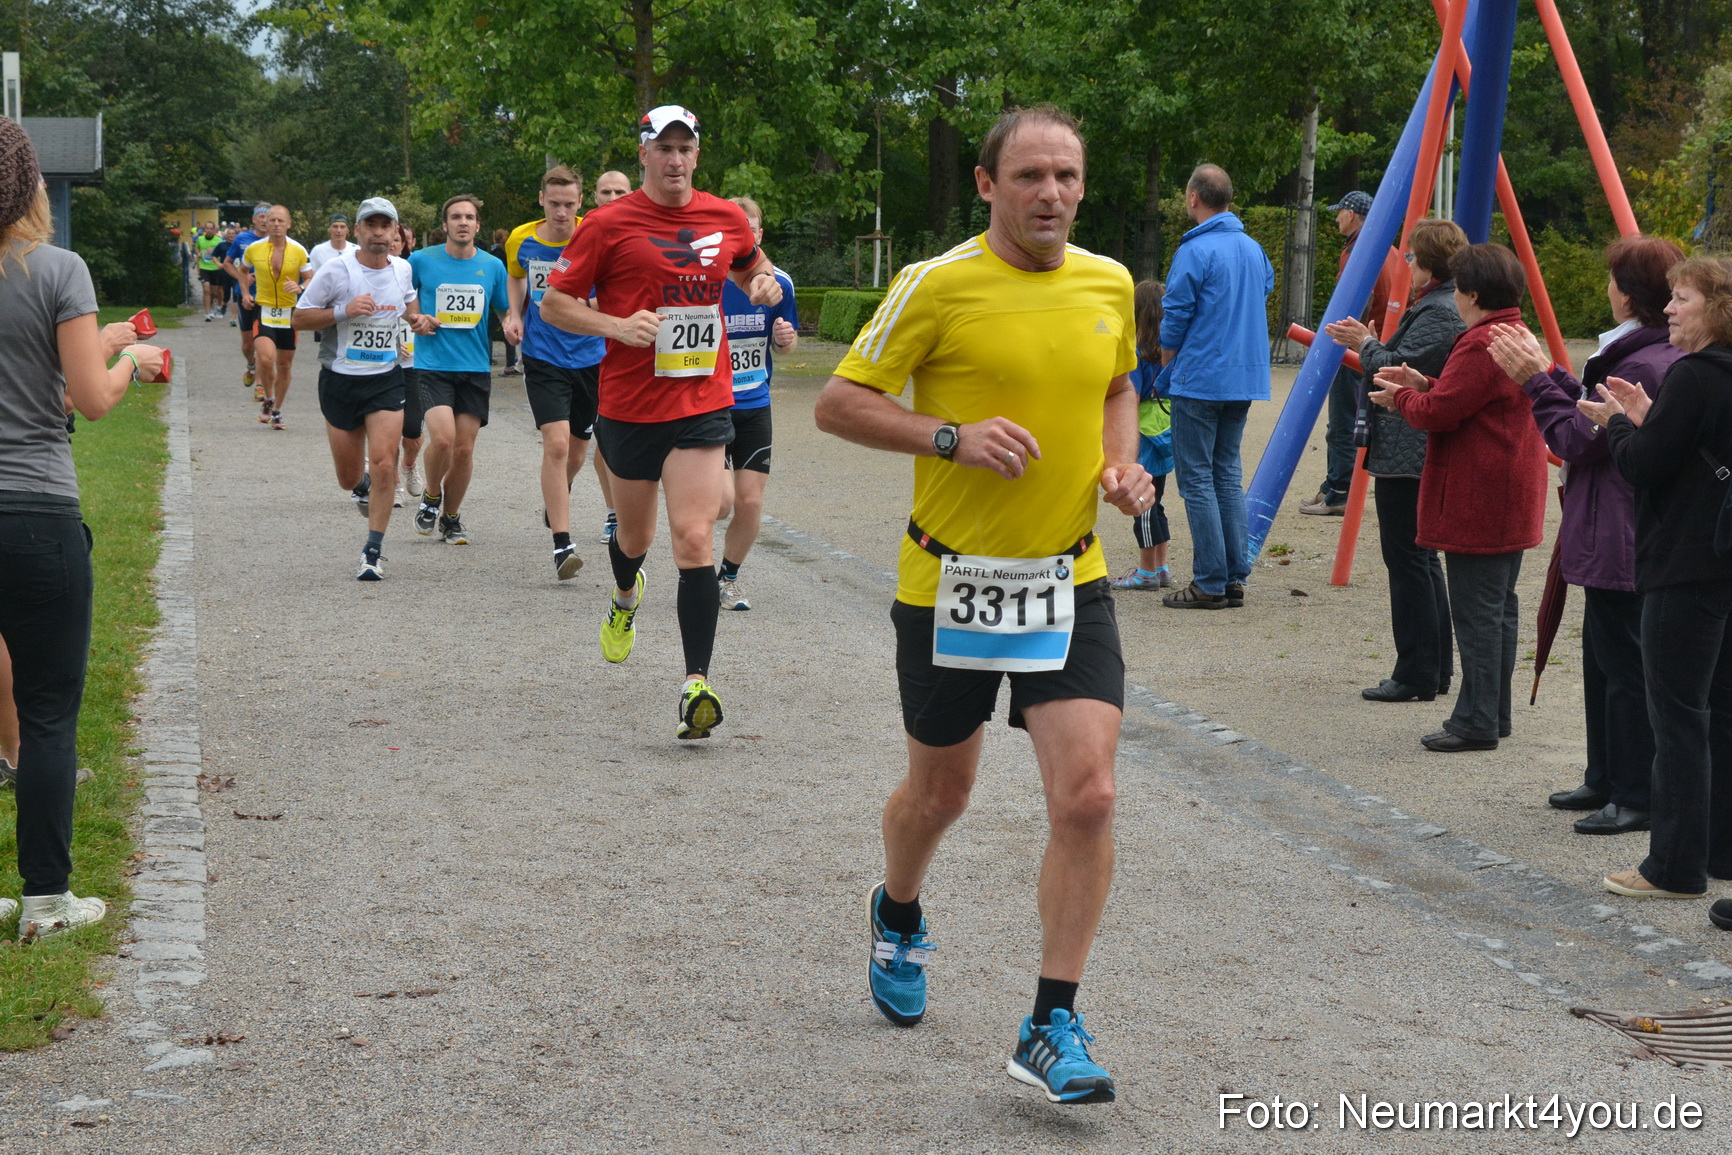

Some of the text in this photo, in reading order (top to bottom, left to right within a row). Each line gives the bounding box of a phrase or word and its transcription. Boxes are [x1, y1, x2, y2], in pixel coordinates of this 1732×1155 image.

[662, 282, 722, 304] RWB
[446, 294, 476, 311] 234
[353, 330, 393, 348] 2352
[672, 322, 715, 350] 204
[360, 352, 384, 361] Roland
[683, 355, 700, 367] Eric
[731, 349, 761, 371] 836
[944, 565, 1051, 581] PARTL Neumarkt
[950, 582, 1056, 627] 3311
